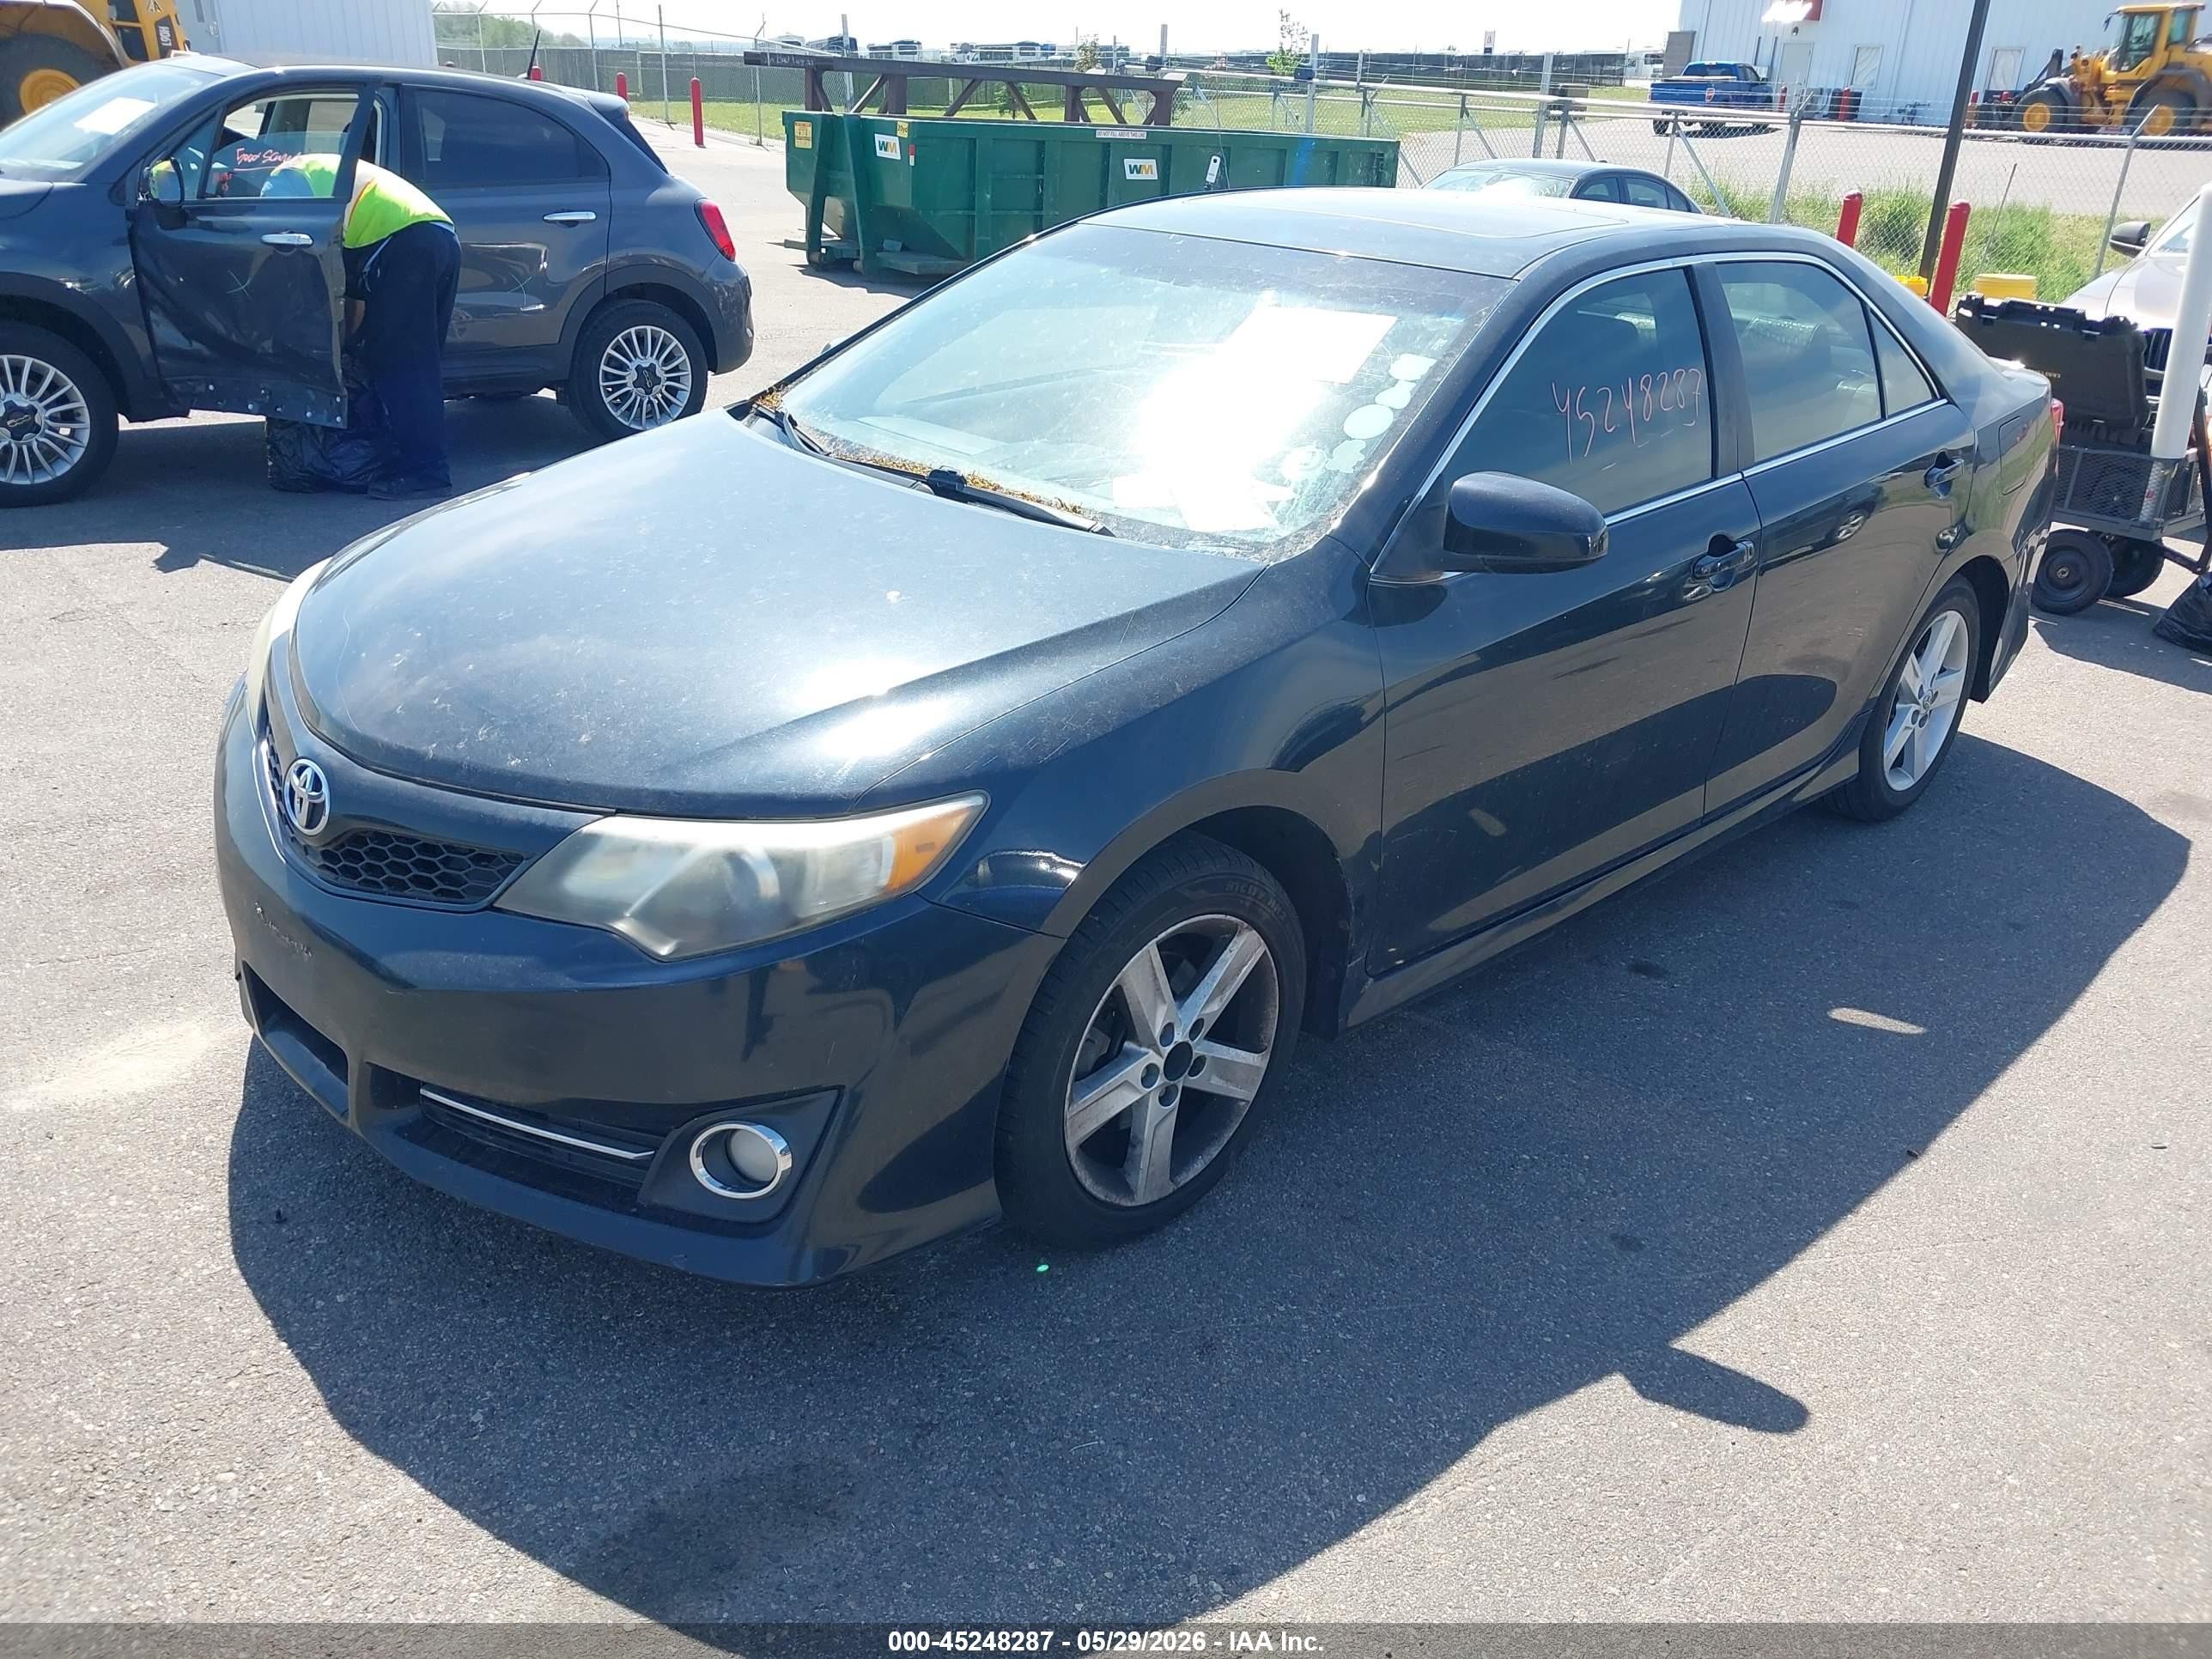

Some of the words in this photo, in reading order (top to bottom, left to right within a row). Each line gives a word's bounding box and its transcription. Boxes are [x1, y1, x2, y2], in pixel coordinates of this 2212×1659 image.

[878, 140, 897, 154] WM
[1128, 164, 1153, 174] WM
[1552, 368, 1702, 465] 45248287
